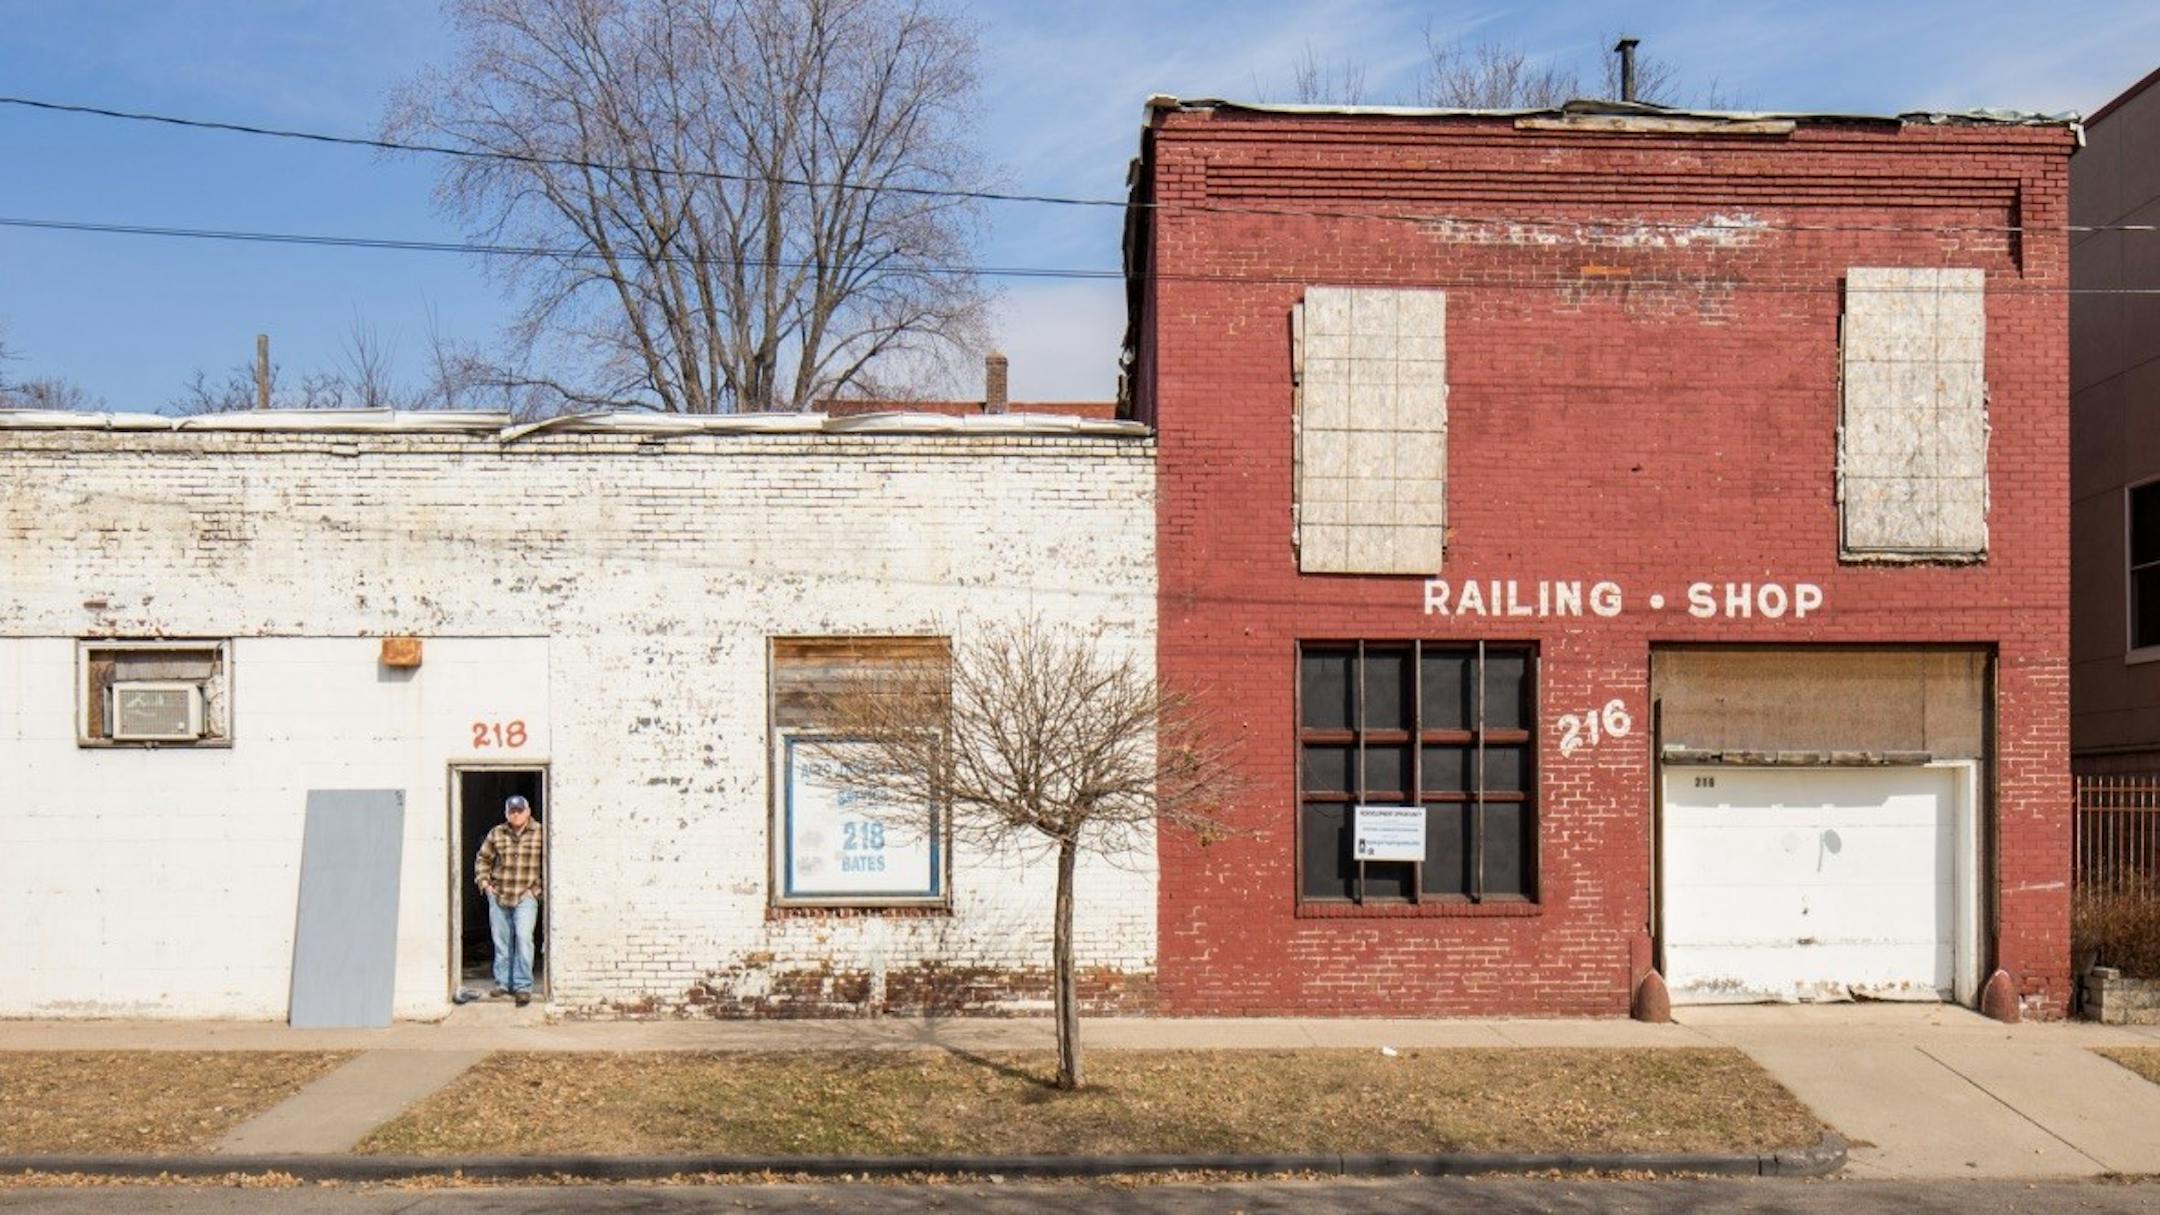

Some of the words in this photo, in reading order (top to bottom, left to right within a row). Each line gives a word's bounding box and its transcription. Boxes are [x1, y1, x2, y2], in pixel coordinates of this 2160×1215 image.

[1423, 580, 1622, 617] RAILING
[1687, 583, 1823, 618] SHOP
[472, 720, 528, 748] 218
[1557, 698, 1632, 758] 216
[842, 821, 885, 850] 218
[841, 855, 885, 872] BATES
